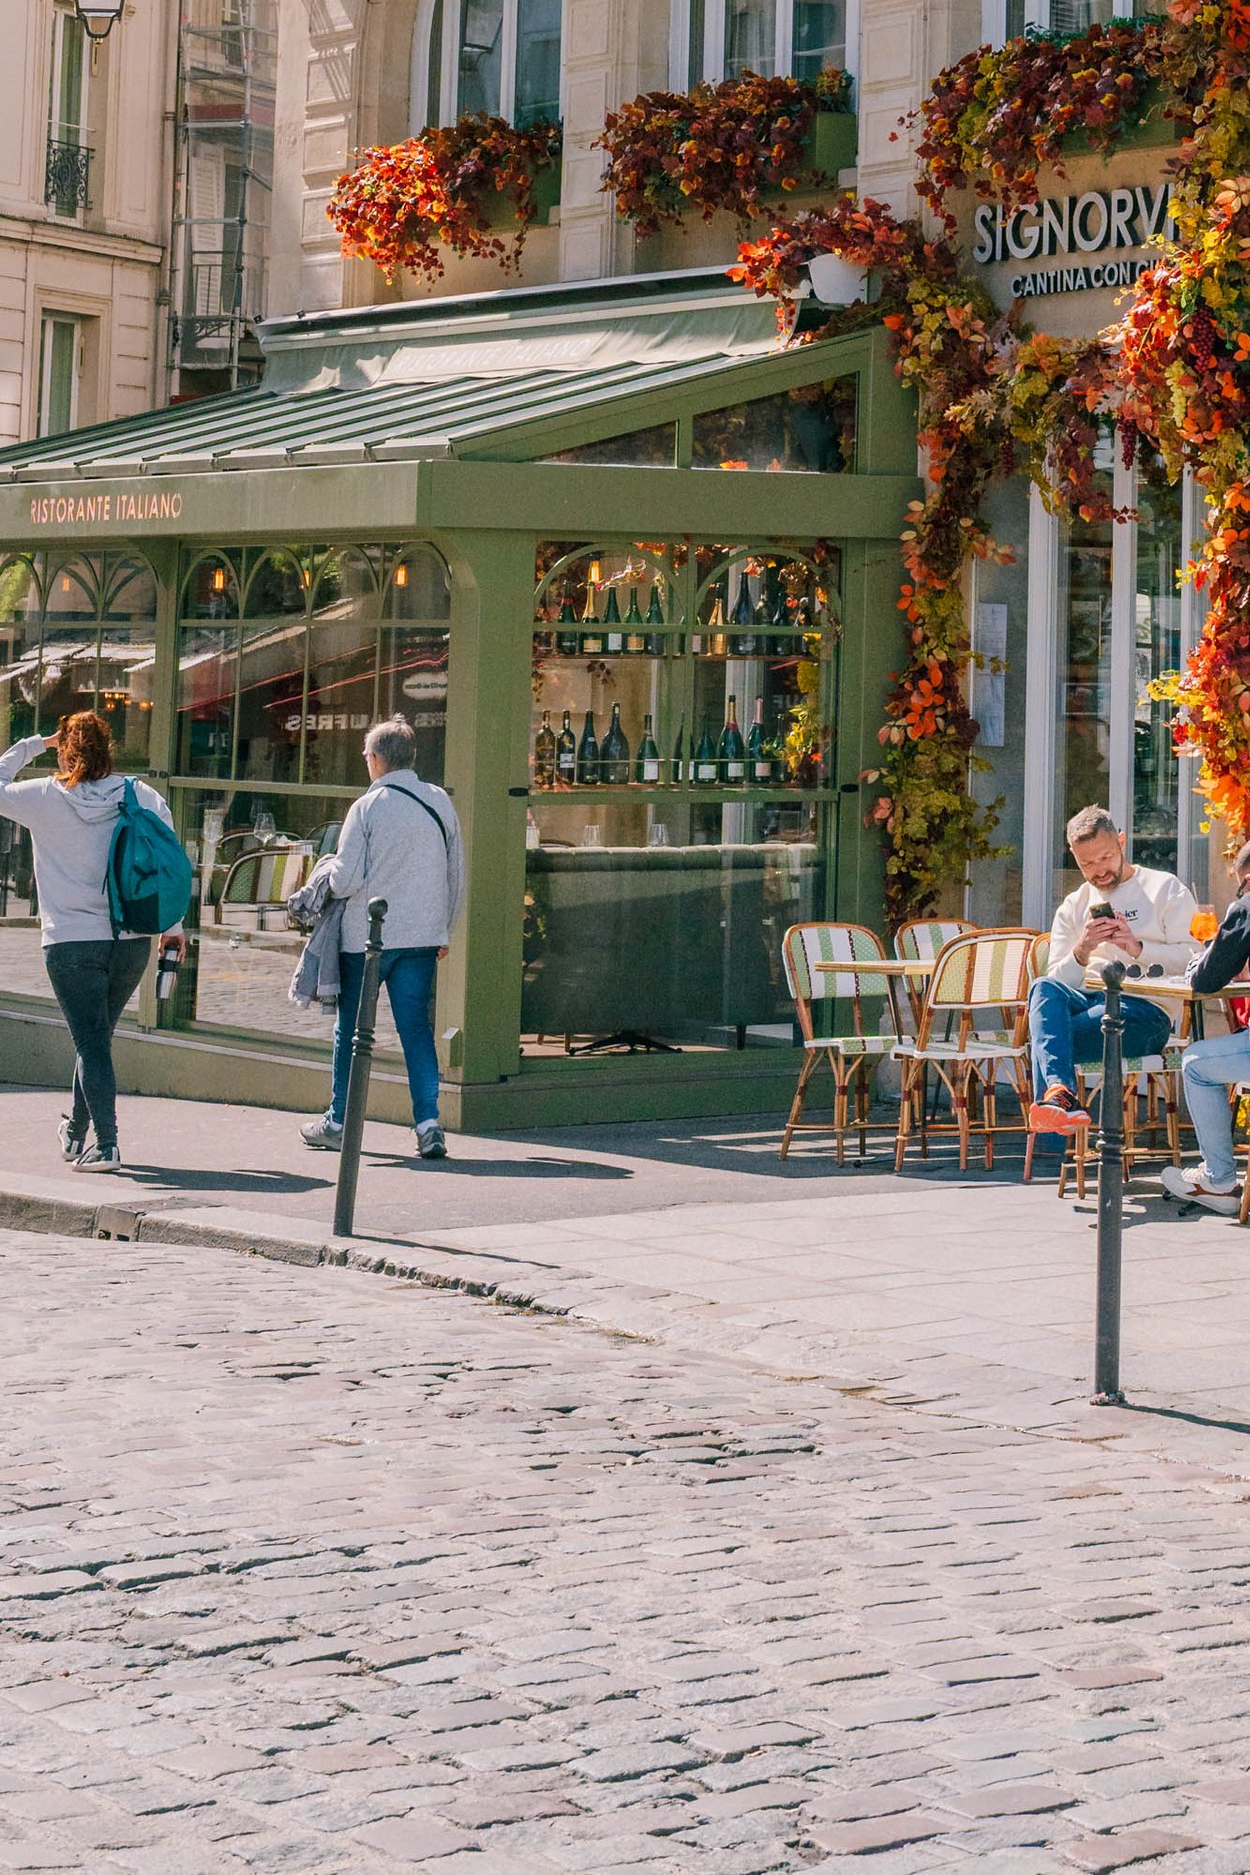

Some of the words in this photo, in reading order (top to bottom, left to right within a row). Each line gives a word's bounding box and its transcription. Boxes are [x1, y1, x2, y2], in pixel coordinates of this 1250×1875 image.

[973, 183, 1177, 263] SIGNORVI
[1011, 268, 1087, 298] CANTINA
[1090, 261, 1130, 288] CON
[30, 495, 110, 524] RISTORANTE
[116, 492, 182, 520] ITALIANO
